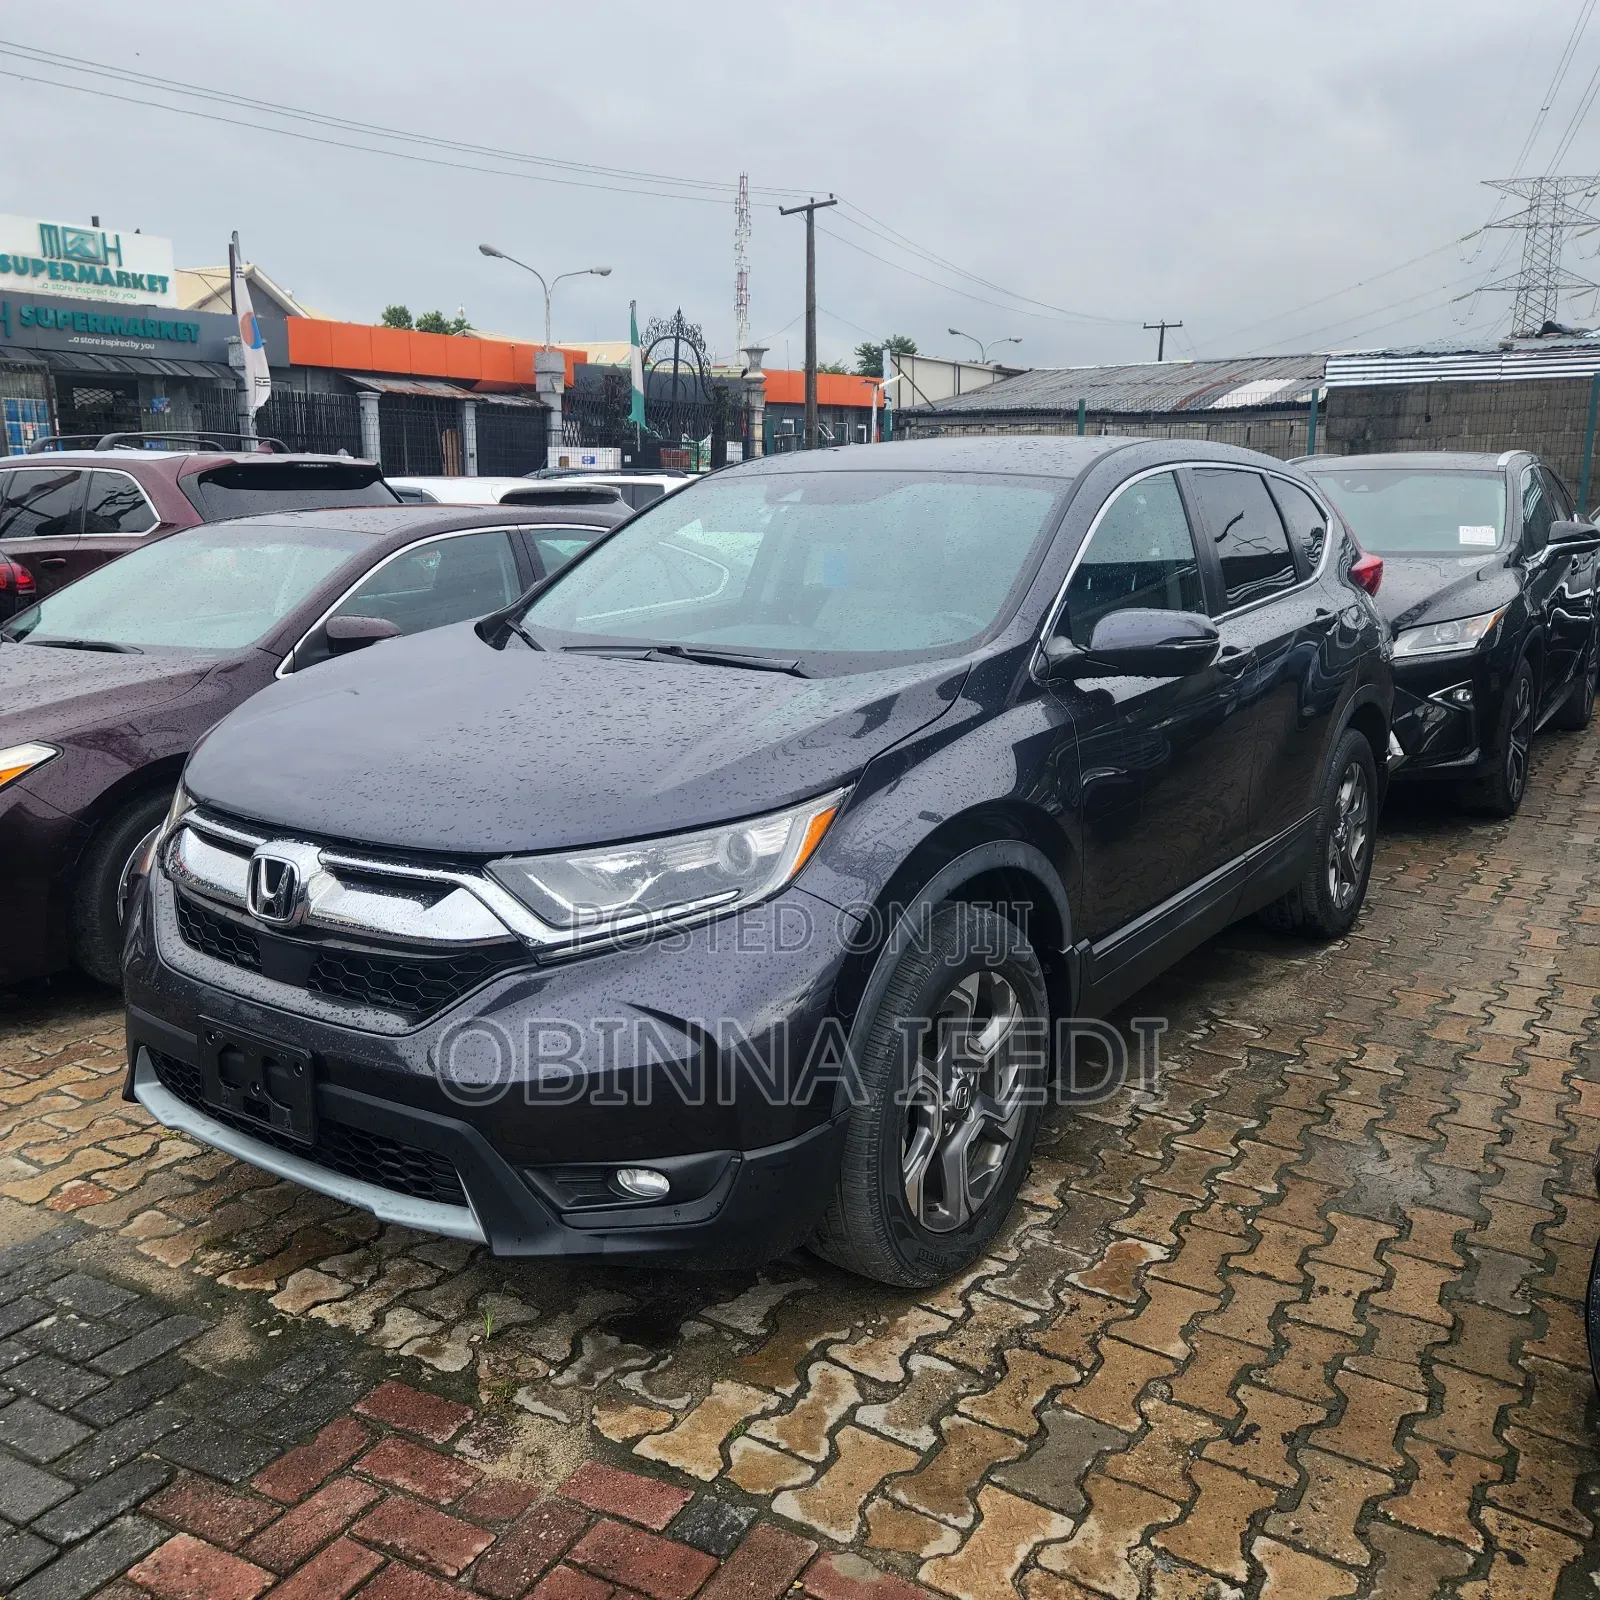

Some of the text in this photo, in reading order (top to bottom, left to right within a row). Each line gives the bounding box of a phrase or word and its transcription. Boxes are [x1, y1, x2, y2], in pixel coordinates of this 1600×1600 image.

[0, 253, 169, 293] SUPERMARKET
[52, 282, 73, 292] store
[76, 285, 107, 297] inspired
[110, 289, 120, 299] by
[122, 291, 137, 300] you
[20, 304, 200, 343] SUPERMARKET
[80, 336, 100, 345] store
[101, 336, 129, 348] inspired
[130, 338, 140, 349] by
[141, 340, 155, 350] you
